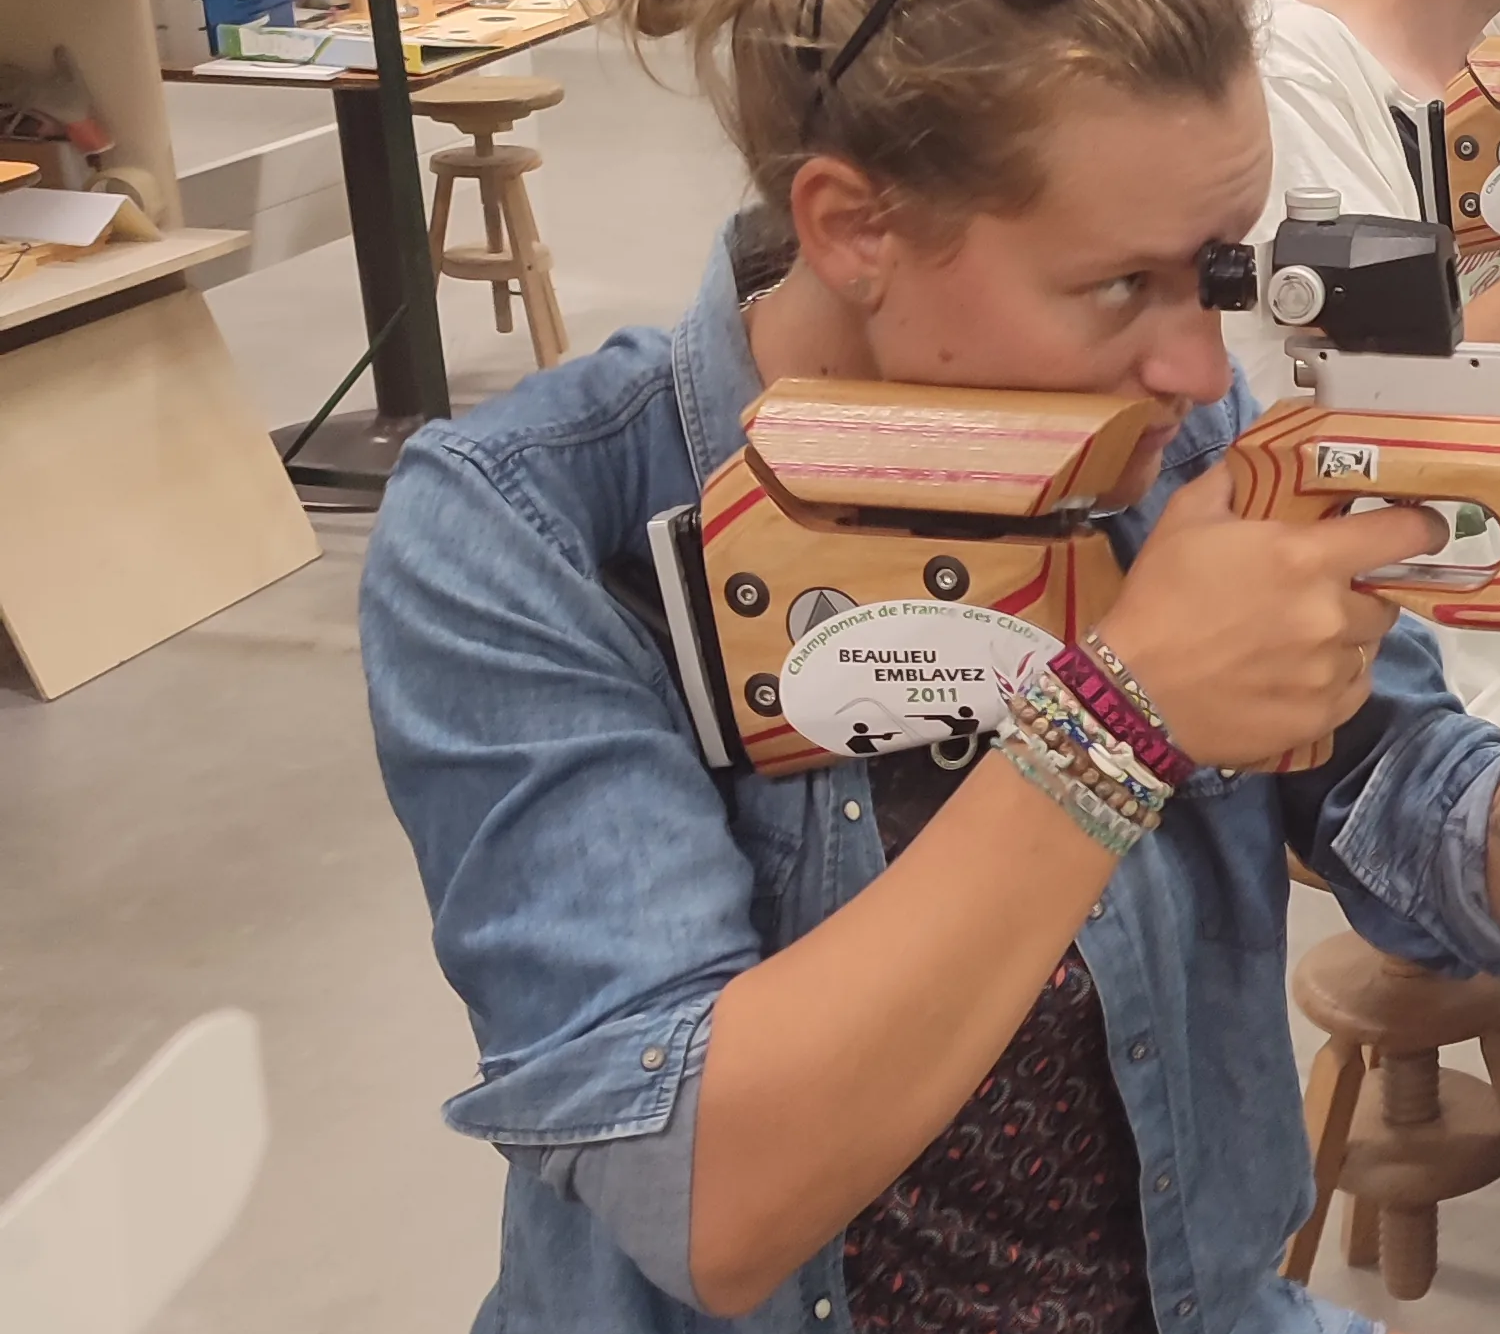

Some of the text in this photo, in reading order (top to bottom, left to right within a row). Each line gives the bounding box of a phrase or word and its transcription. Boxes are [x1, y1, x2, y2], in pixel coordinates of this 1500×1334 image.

[788, 602, 1040, 676] Championnat de Franc des Club
[839, 649, 937, 664] BEAULIEU
[874, 668, 986, 682] EMBLAVEZ
[906, 688, 958, 703] 2011
